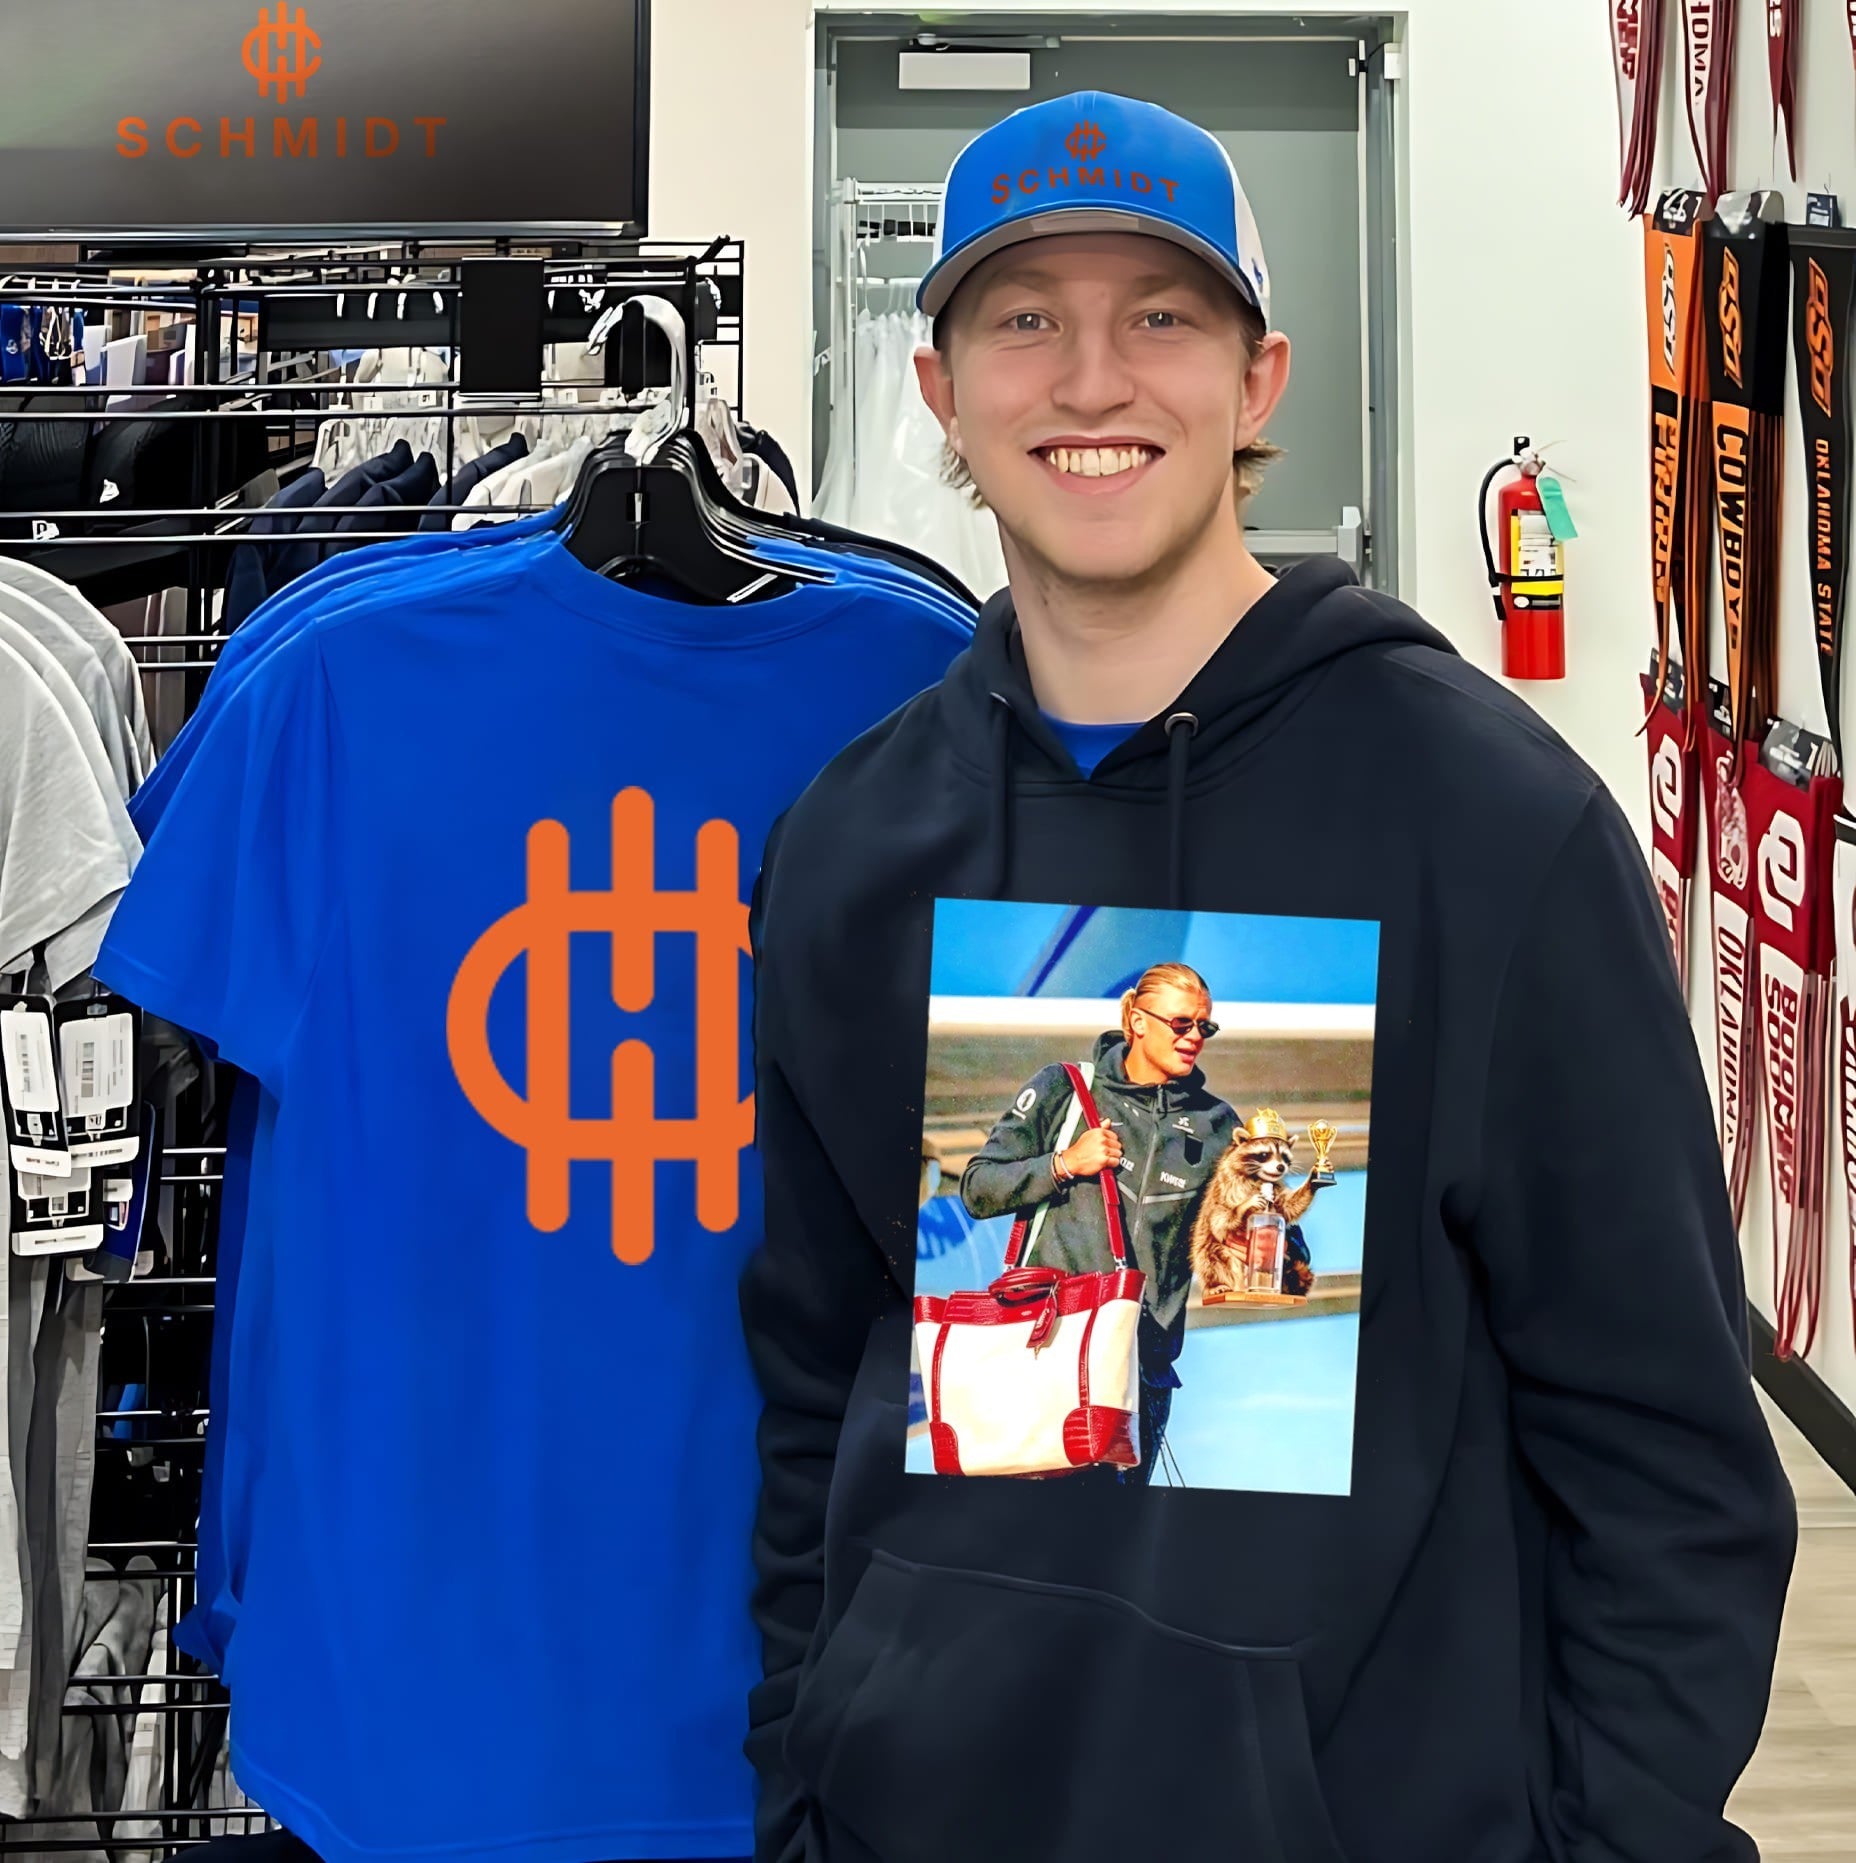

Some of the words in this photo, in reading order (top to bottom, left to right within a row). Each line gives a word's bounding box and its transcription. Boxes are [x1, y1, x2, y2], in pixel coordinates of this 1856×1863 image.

[115, 117, 447, 158] SCHMIDT
[991, 167, 1180, 205] SCHMIDT
[1815, 438, 1832, 570] OKLAHOMA
[1718, 926, 1745, 1144] OKLAHOMA
